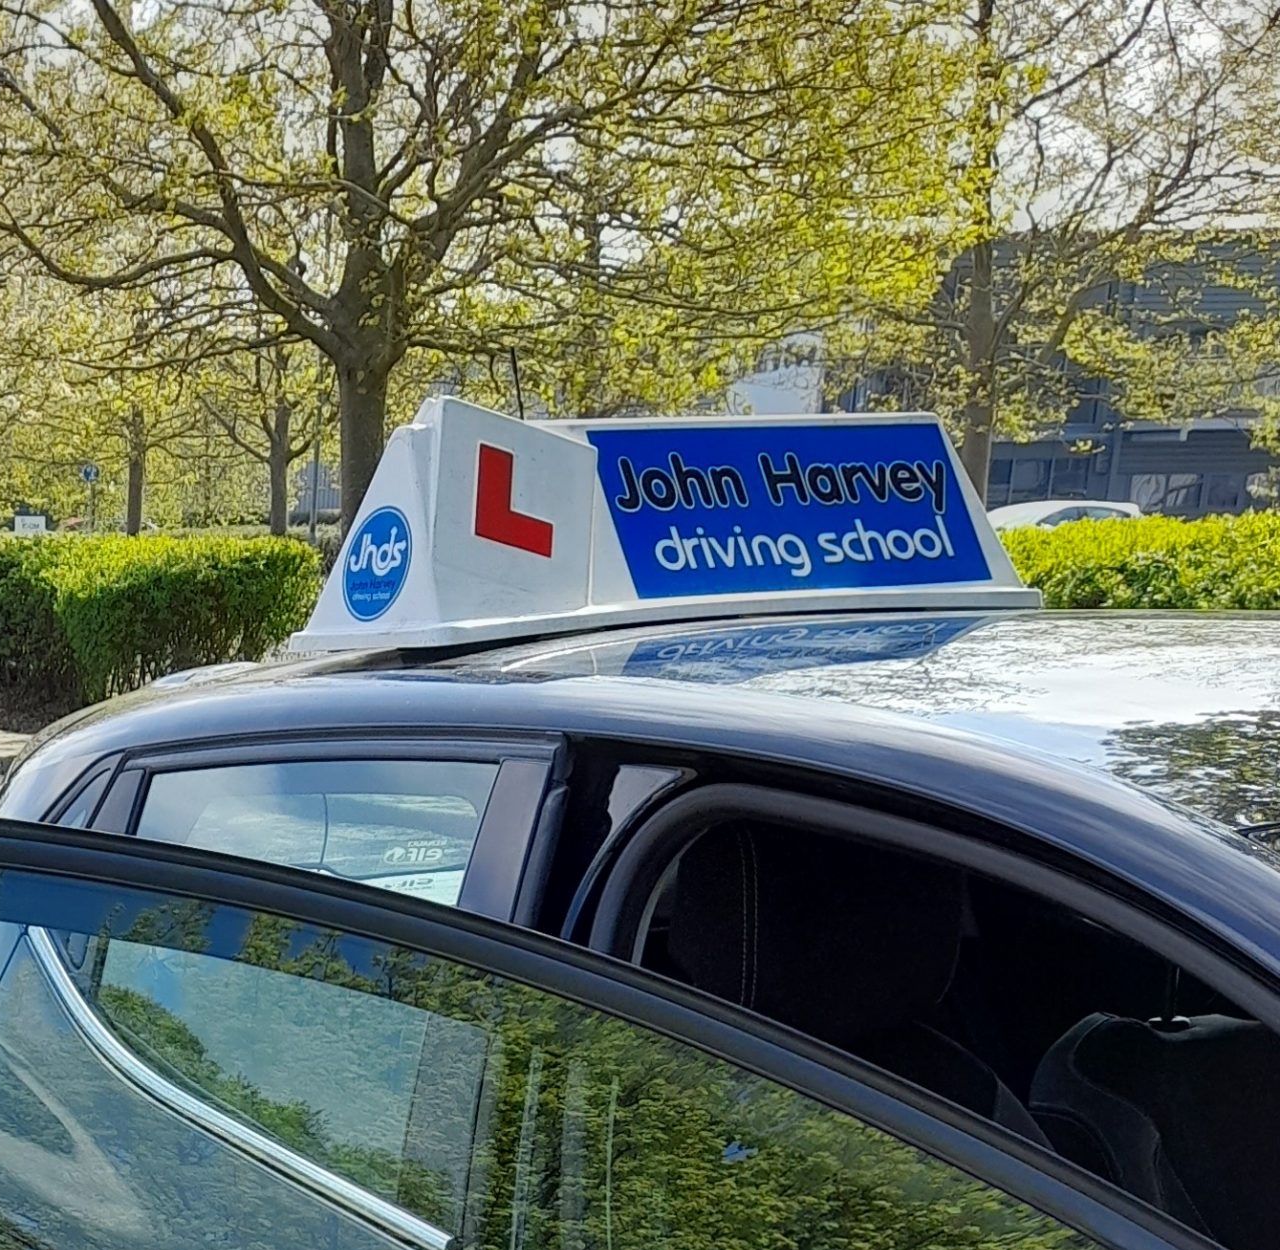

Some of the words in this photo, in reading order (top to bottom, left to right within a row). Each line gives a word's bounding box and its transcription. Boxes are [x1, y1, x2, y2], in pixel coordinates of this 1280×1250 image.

[474, 442, 553, 558] L
[615, 452, 749, 513] John
[757, 452, 946, 514] Harvey
[654, 525, 812, 577] driving
[818, 515, 955, 563] school
